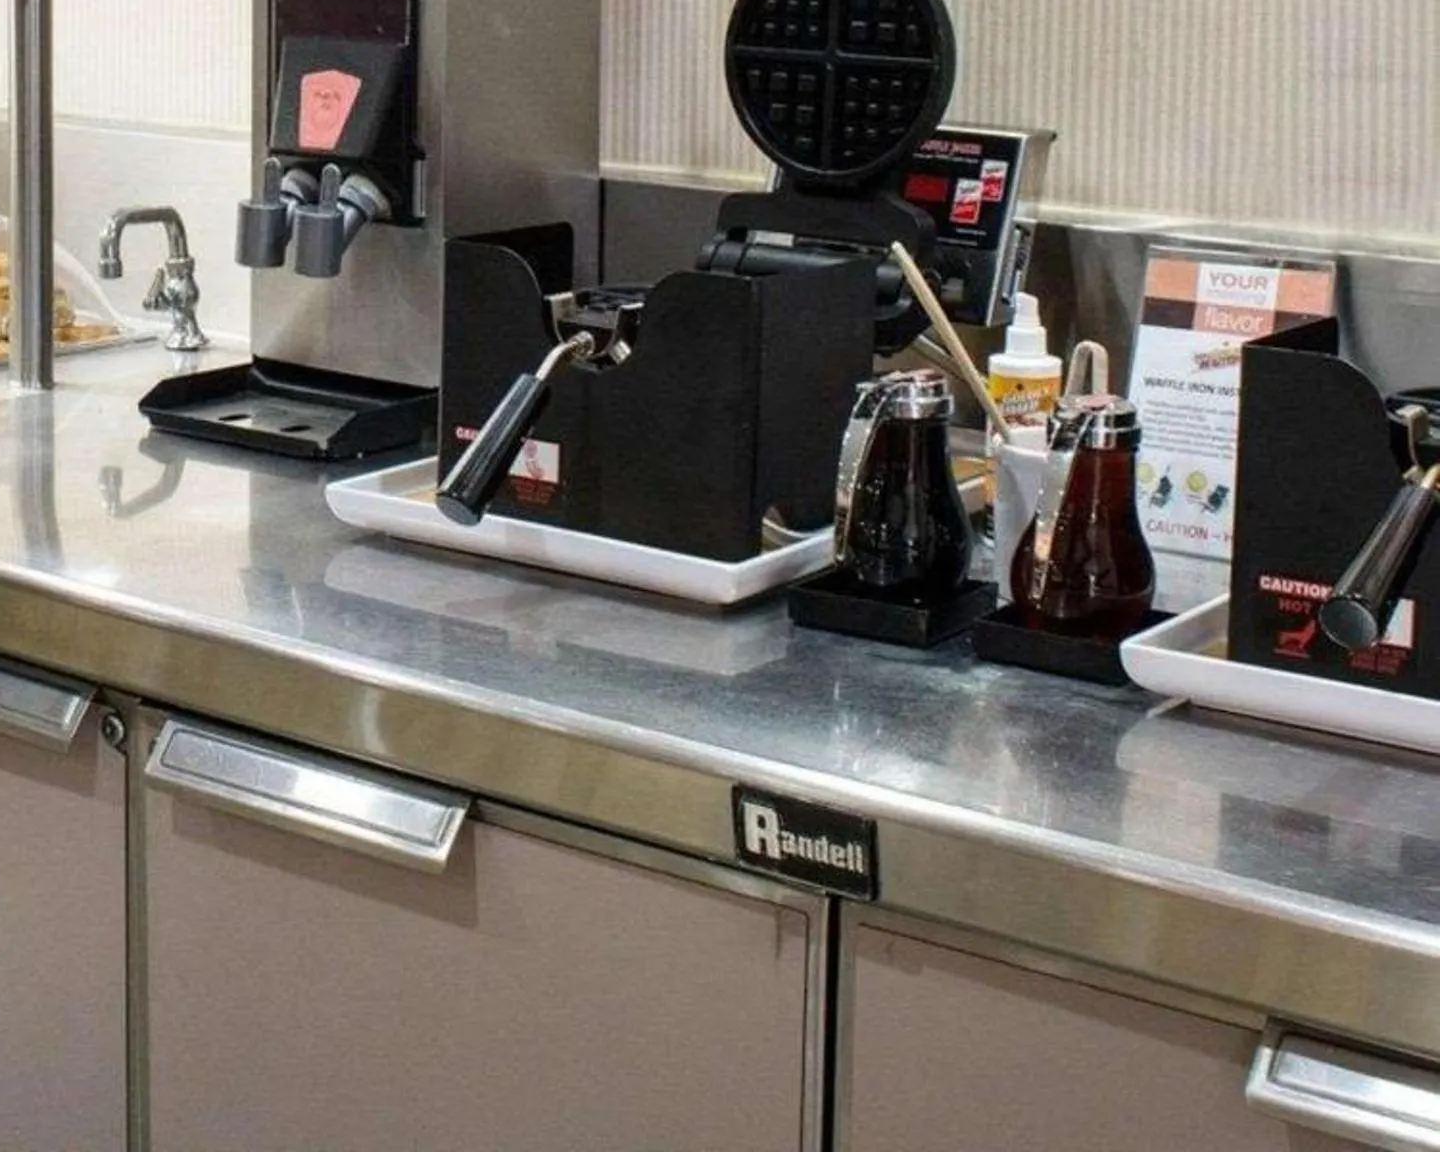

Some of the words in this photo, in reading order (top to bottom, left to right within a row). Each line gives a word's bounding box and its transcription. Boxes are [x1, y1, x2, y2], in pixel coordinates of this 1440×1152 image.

[1209, 270, 1268, 290] YOUR
[1205, 306, 1264, 333] flavor
[1146, 519, 1209, 540] CAUTION
[743, 801, 864, 874] Randell
